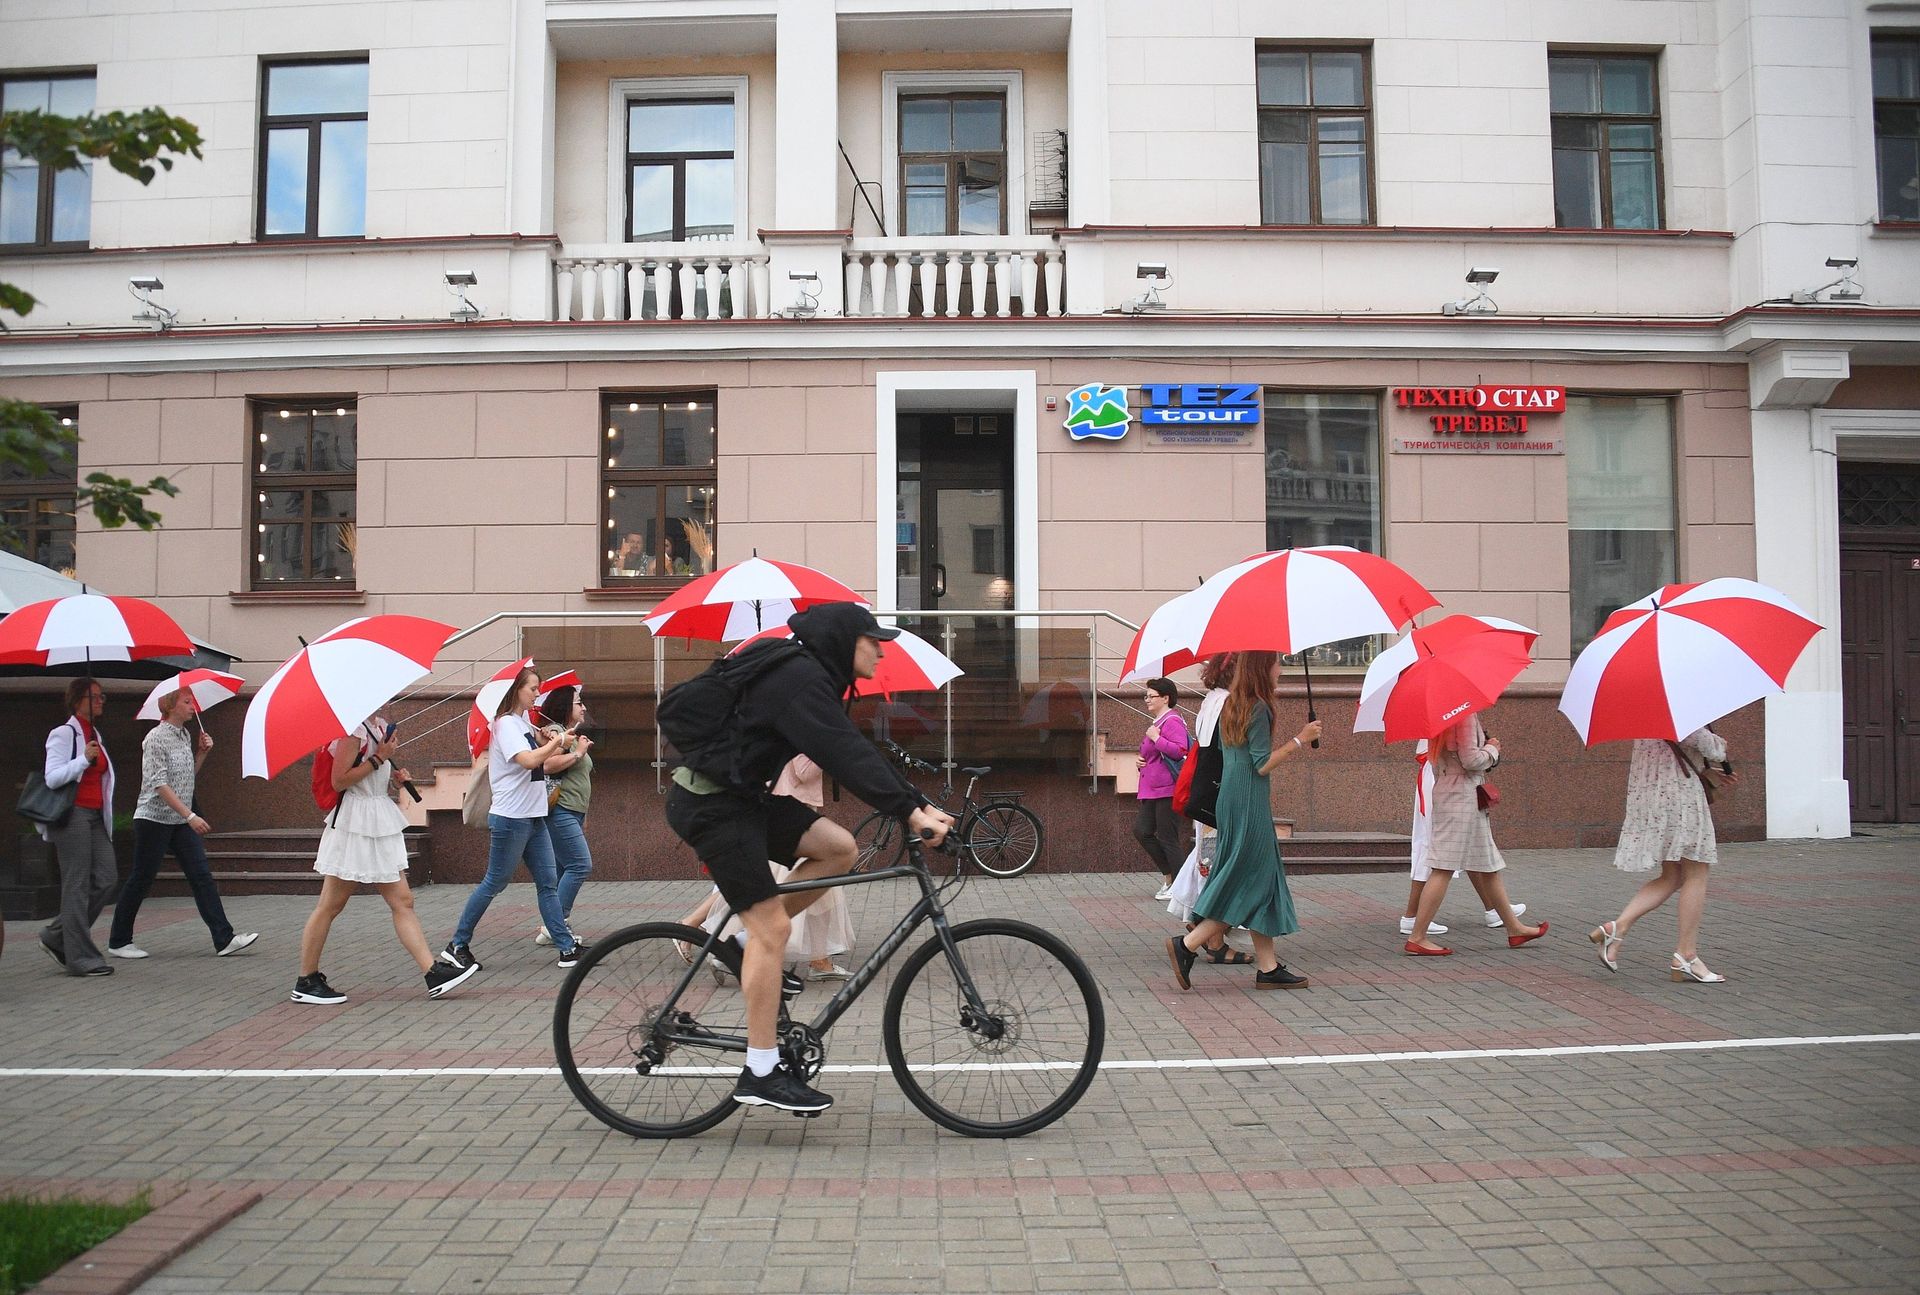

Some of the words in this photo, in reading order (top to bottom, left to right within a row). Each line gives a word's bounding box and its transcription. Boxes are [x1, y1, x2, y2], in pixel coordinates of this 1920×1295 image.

[1141, 383, 1260, 408] TEZ
[1394, 388, 1487, 408] ТЕХНО
[1492, 388, 1560, 408] СТАР
[1153, 409, 1249, 422] tour
[1430, 414, 1528, 434] ТРЕВЕЛ
[1403, 441, 1490, 450] ТУРИСТИЧЕСКАЯ
[1496, 441, 1554, 450] КОМПАНИЯ
